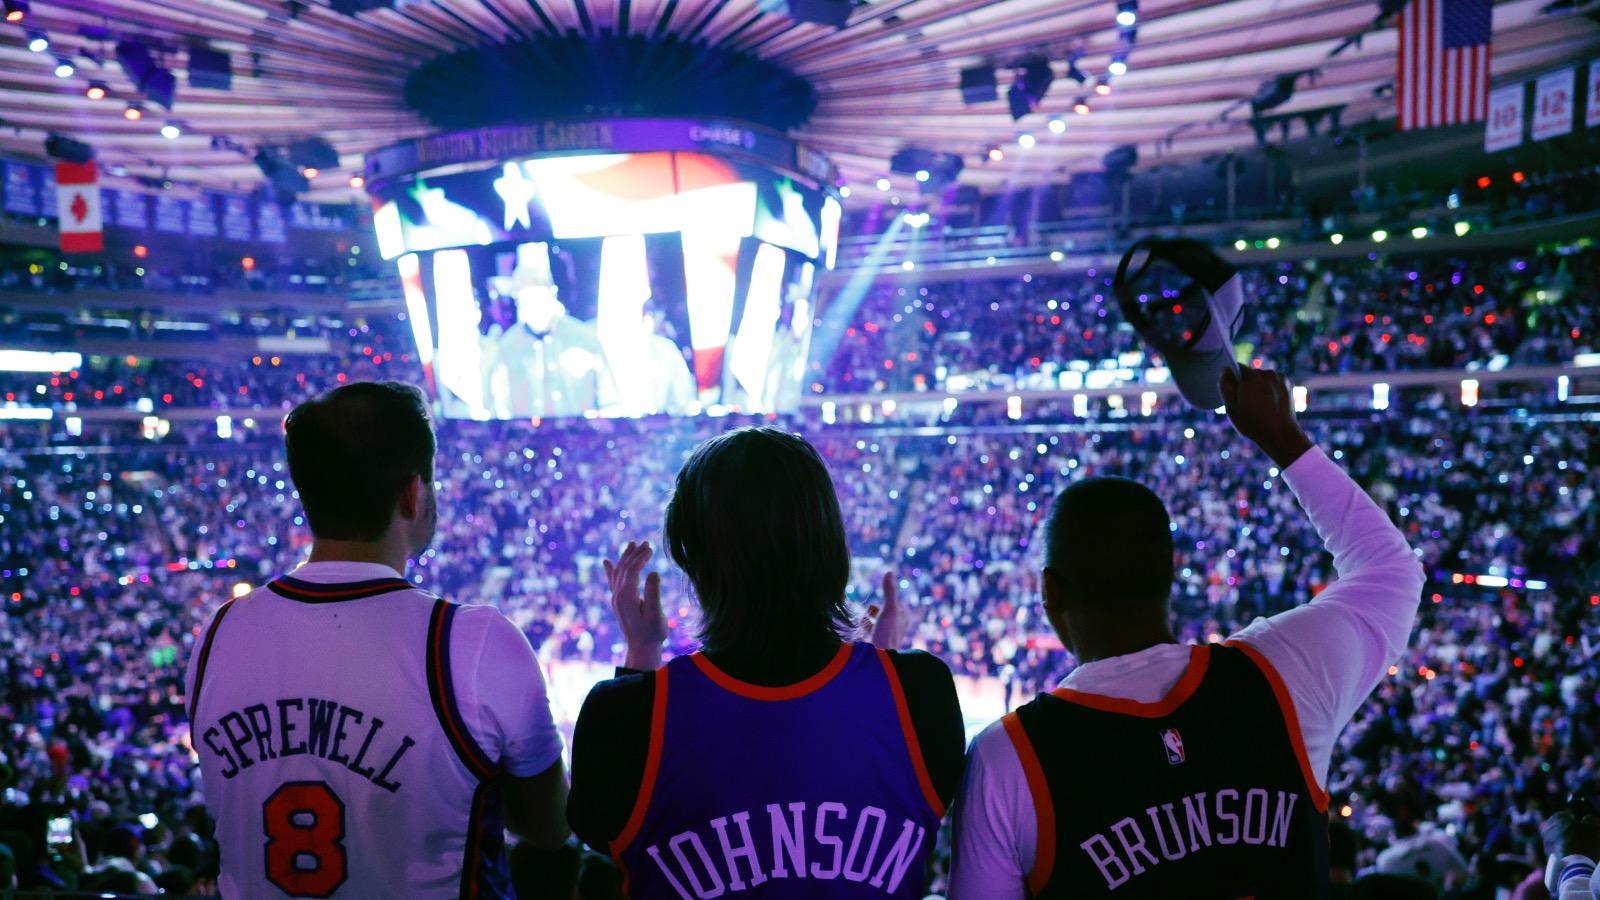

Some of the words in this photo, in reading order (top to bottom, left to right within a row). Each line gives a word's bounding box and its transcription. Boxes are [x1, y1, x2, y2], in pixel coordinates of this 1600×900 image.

[203, 697, 416, 793] SPREWELL
[262, 780, 349, 899] 8
[1080, 788, 1298, 891] BRUNSON
